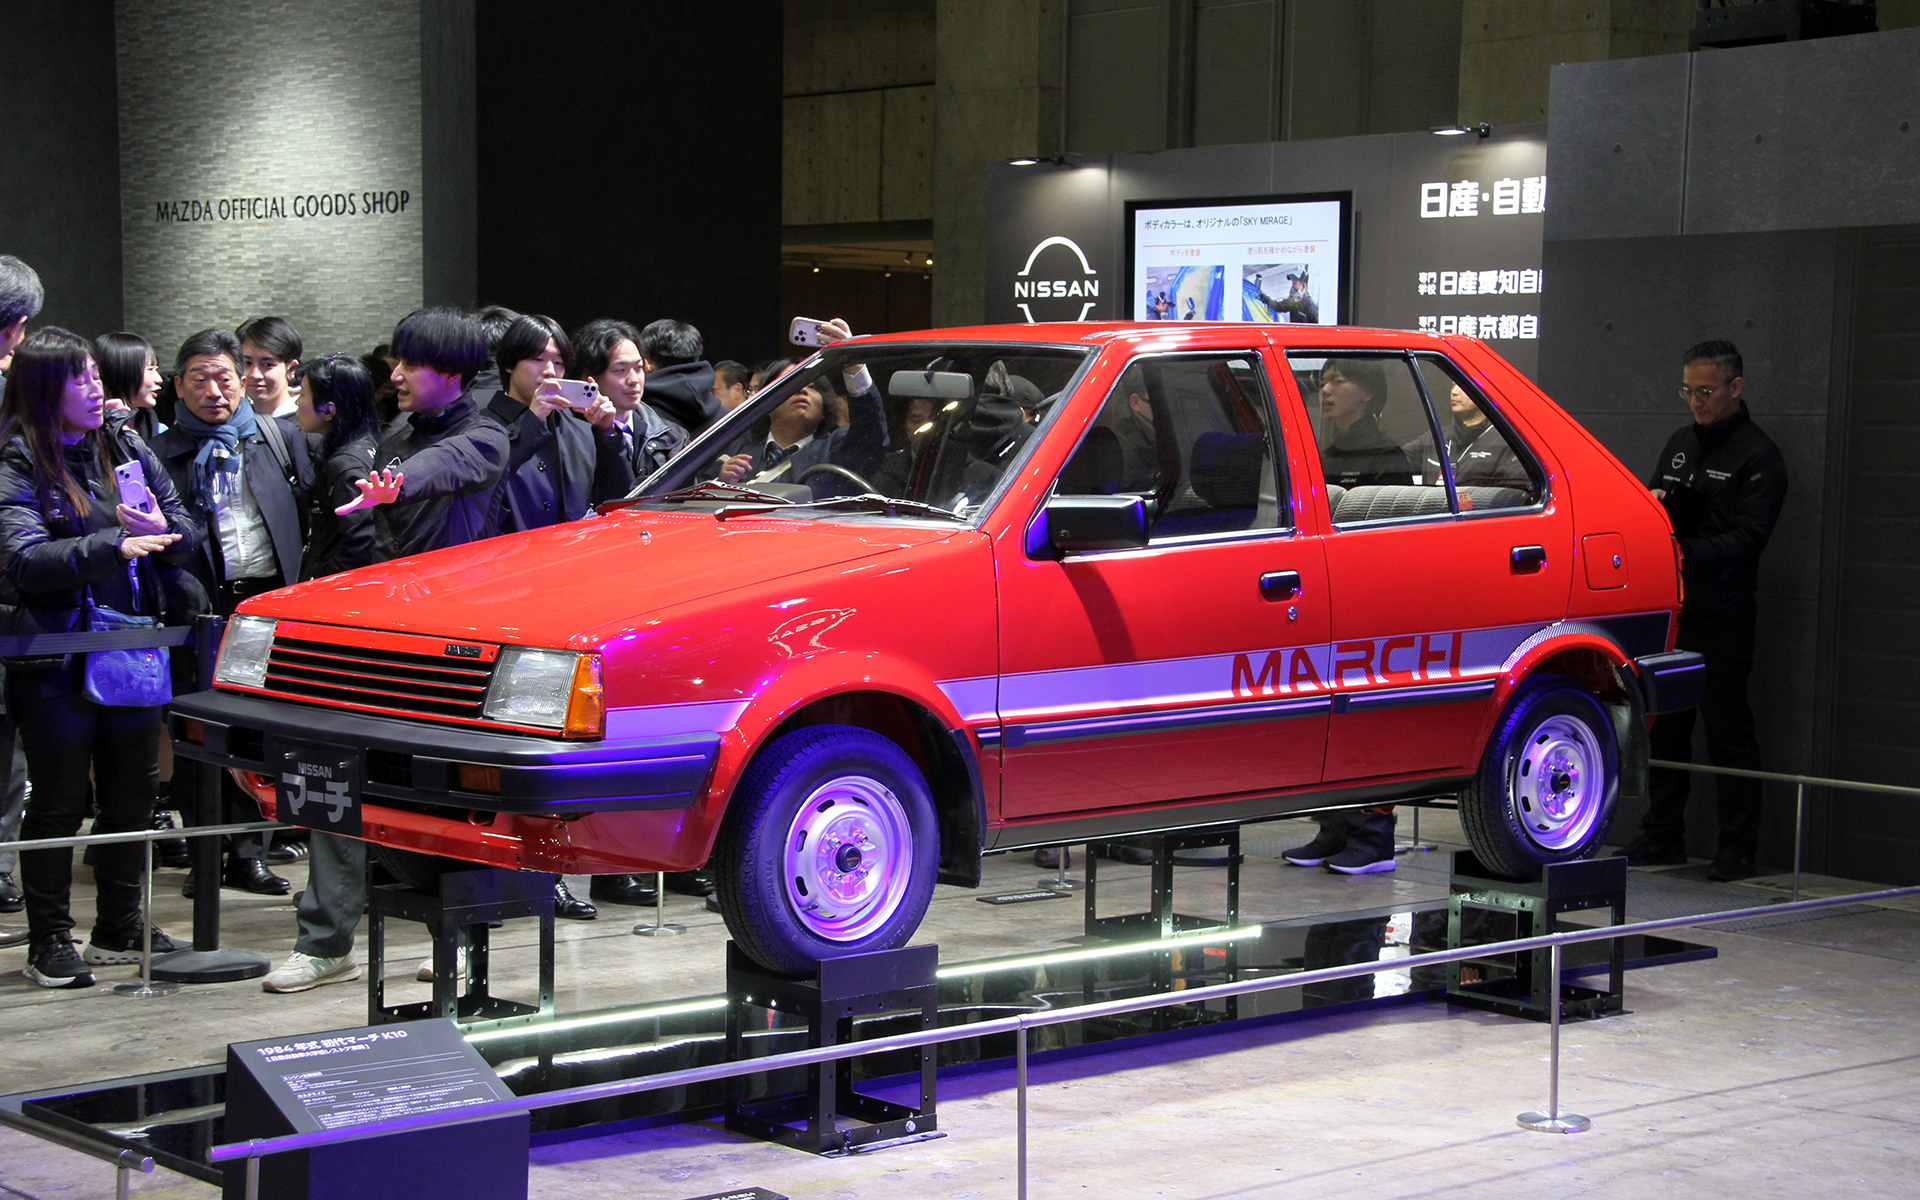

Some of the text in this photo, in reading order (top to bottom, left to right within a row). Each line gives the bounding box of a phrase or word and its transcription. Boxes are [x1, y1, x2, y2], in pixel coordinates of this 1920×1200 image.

[156, 190, 410, 222] MAZDA OFFICIAL GOODS SHOP
[1015, 280, 1099, 298] NISSAN
[1440, 269, 1543, 295] 日産愛知自
[1231, 632, 1462, 697] MARCH
[298, 762, 332, 778] NISSAN
[282, 772, 352, 823] マーチ
[256, 1044, 294, 1056] 1984
[381, 1030, 408, 1040] K10
